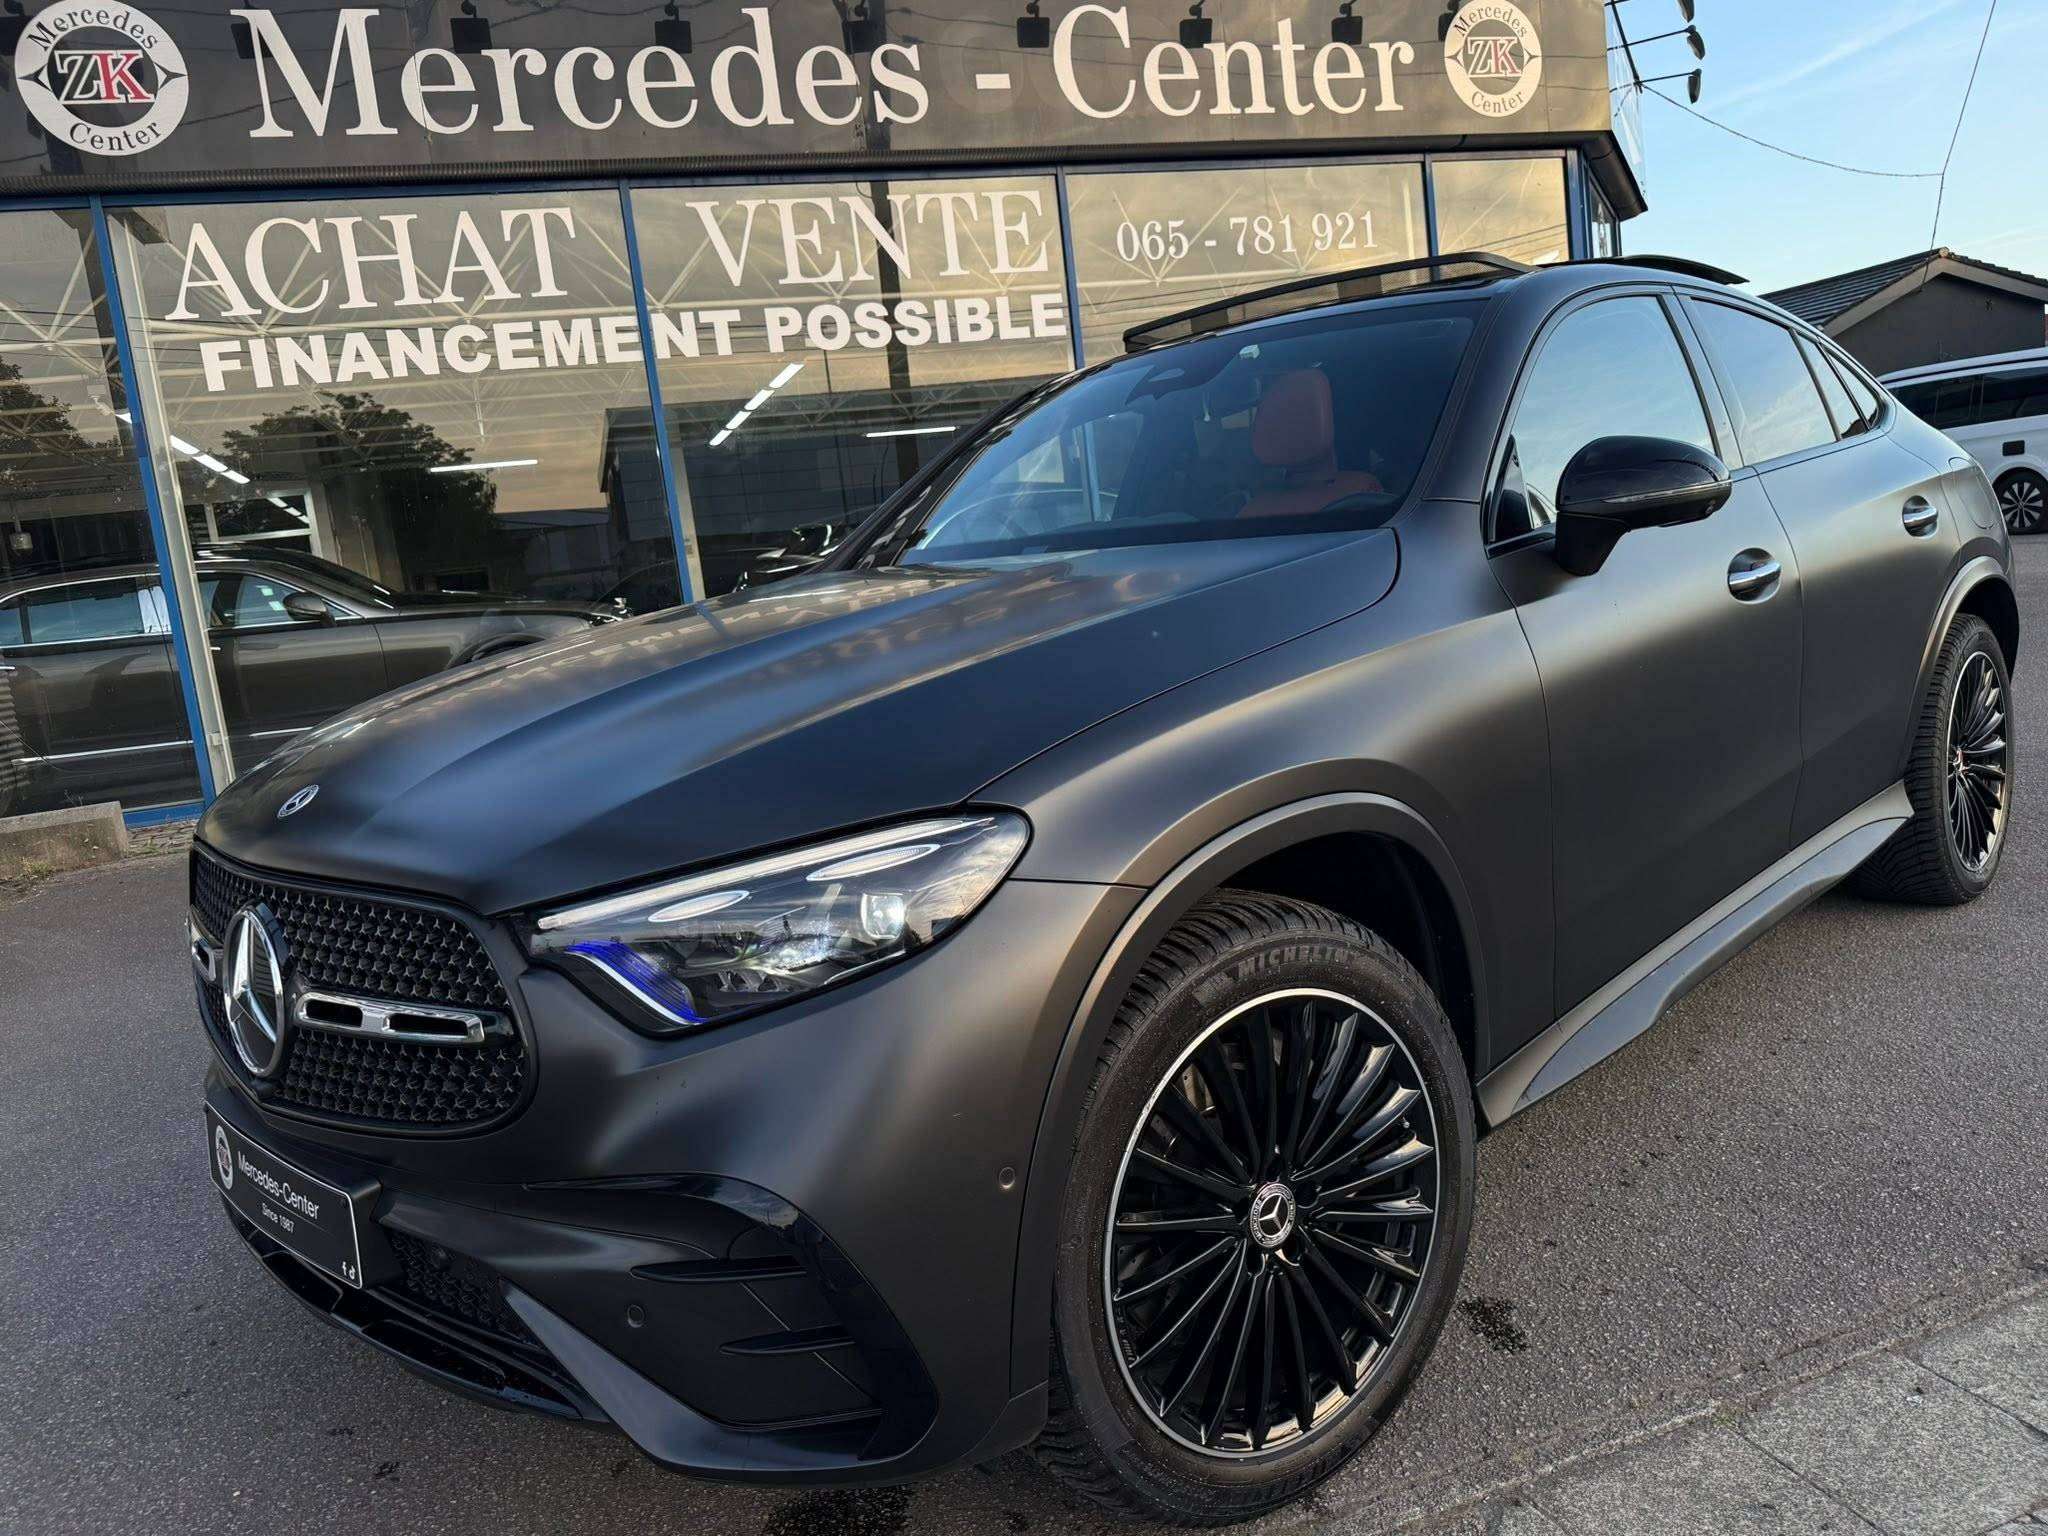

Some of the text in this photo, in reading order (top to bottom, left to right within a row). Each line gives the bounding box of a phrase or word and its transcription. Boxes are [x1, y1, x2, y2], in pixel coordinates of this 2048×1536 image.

[26, 8, 158, 51] Mercedes
[1454, 6, 1527, 37] Mercedes
[54, 49, 156, 105] ZK
[230, 4, 1415, 138] Mercedes - Center
[1467, 36, 1522, 78] ZK
[1472, 91, 1524, 113] Center
[69, 122, 161, 151] Center
[165, 190, 1049, 320] ACHAT VENTE
[1116, 219, 1189, 262] 065
[1229, 214, 1297, 256] 781
[1311, 210, 1378, 251] 921
[200, 293, 1067, 392] FINANCEMENT POSSIBLE
[1237, 946, 1349, 979] MICHELIN
[237, 1150, 320, 1220] Mercedes-Center
